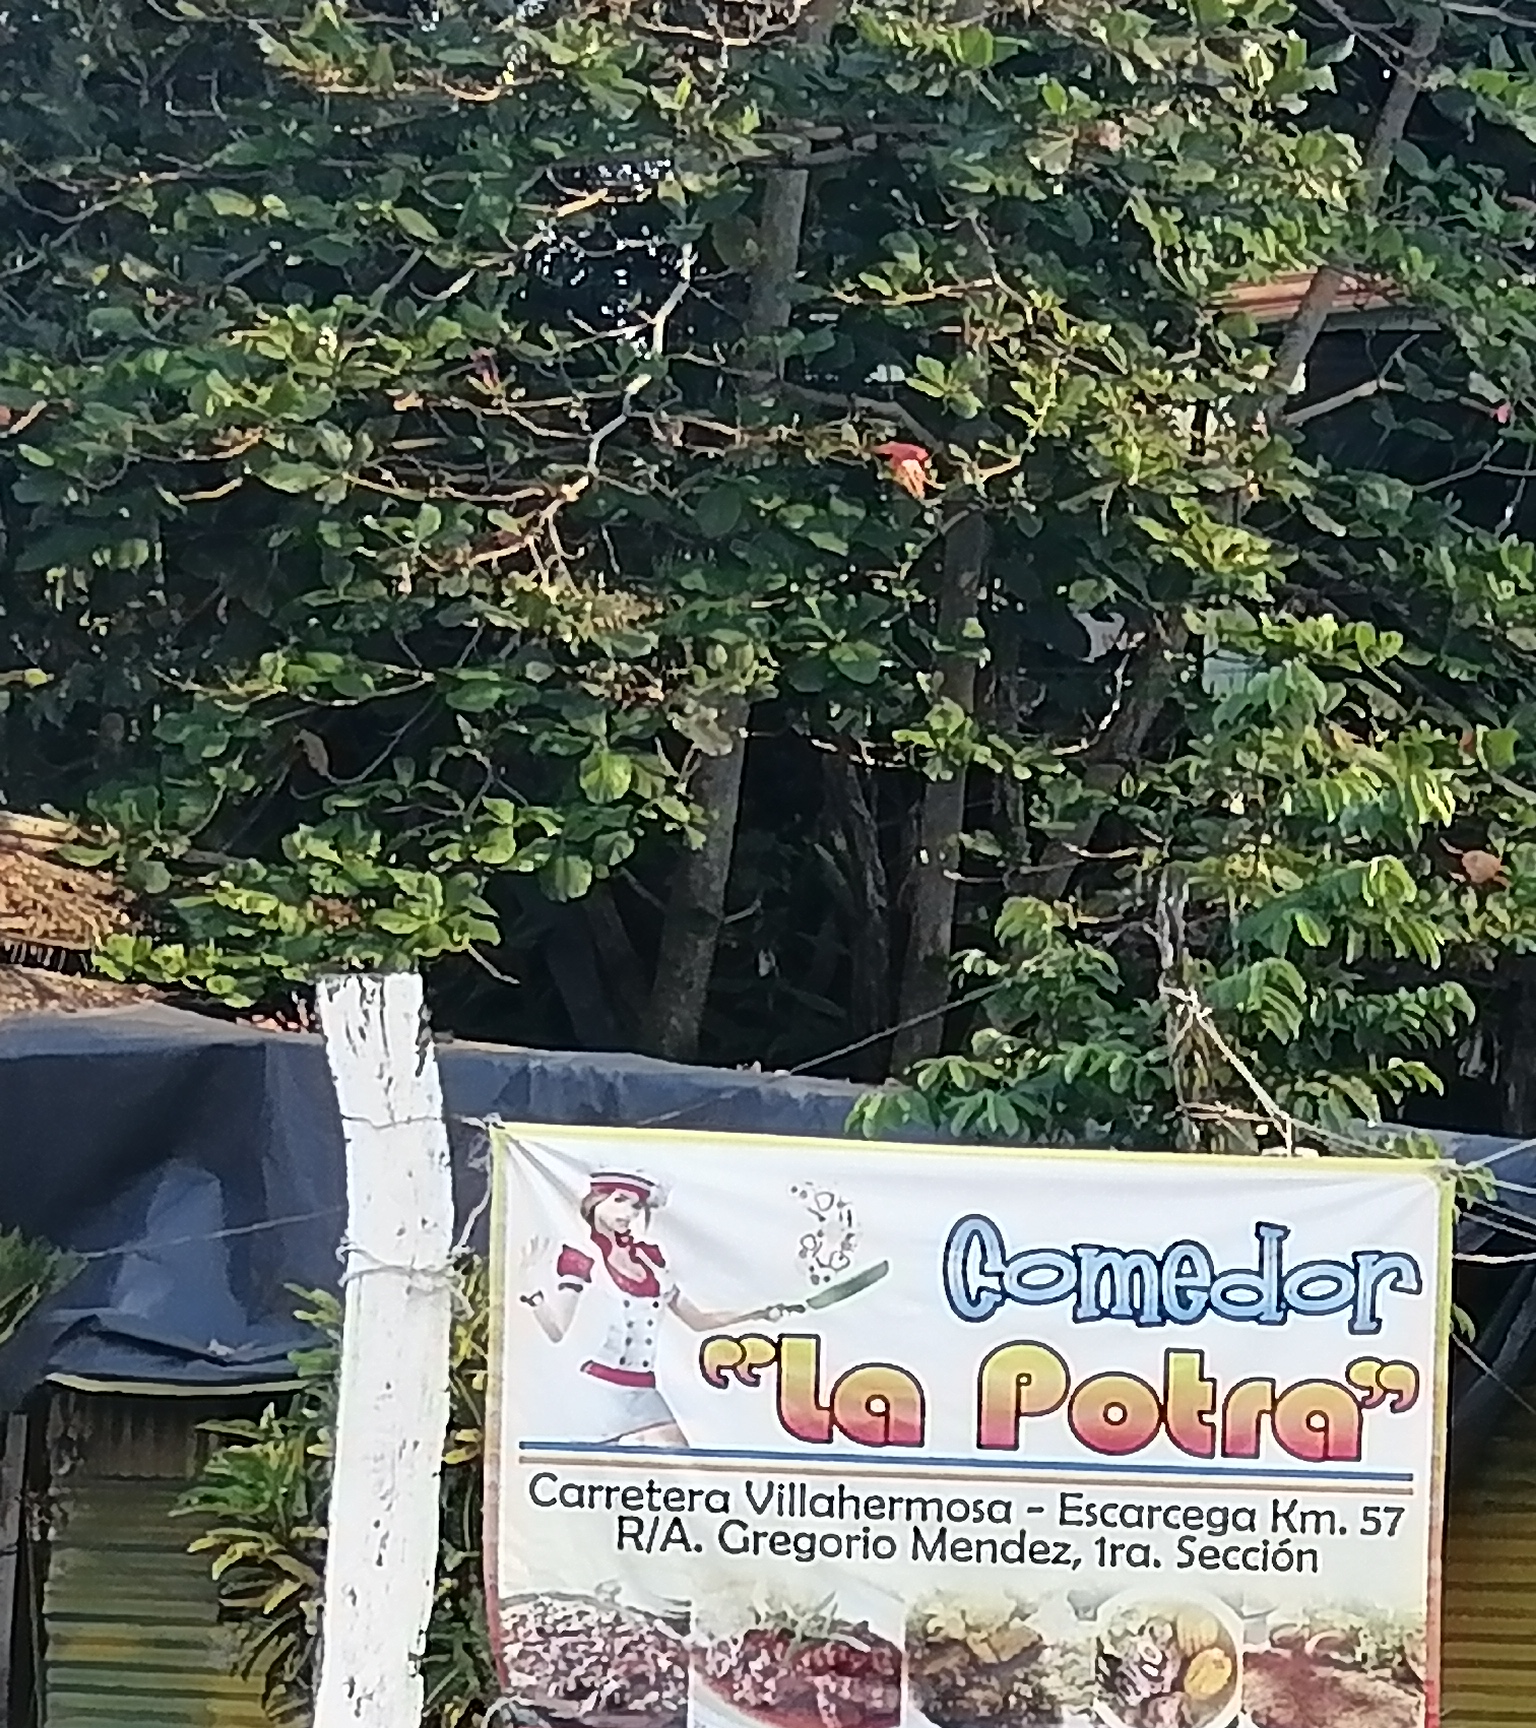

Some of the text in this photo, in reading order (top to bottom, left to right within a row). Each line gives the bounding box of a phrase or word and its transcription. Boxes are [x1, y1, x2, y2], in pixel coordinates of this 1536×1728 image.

[944, 1214, 1422, 1334] Comedor
[529, 1472, 730, 1513] Carretera
[746, 1480, 1012, 1524] Villahermosa
[1059, 1492, 1256, 1536] Escarcega
[1271, 1499, 1347, 1535] Km.
[1360, 1506, 1405, 1537] 57
[617, 1515, 1319, 1573] R/A. Gregorio Mendez, 1ra. Sección
